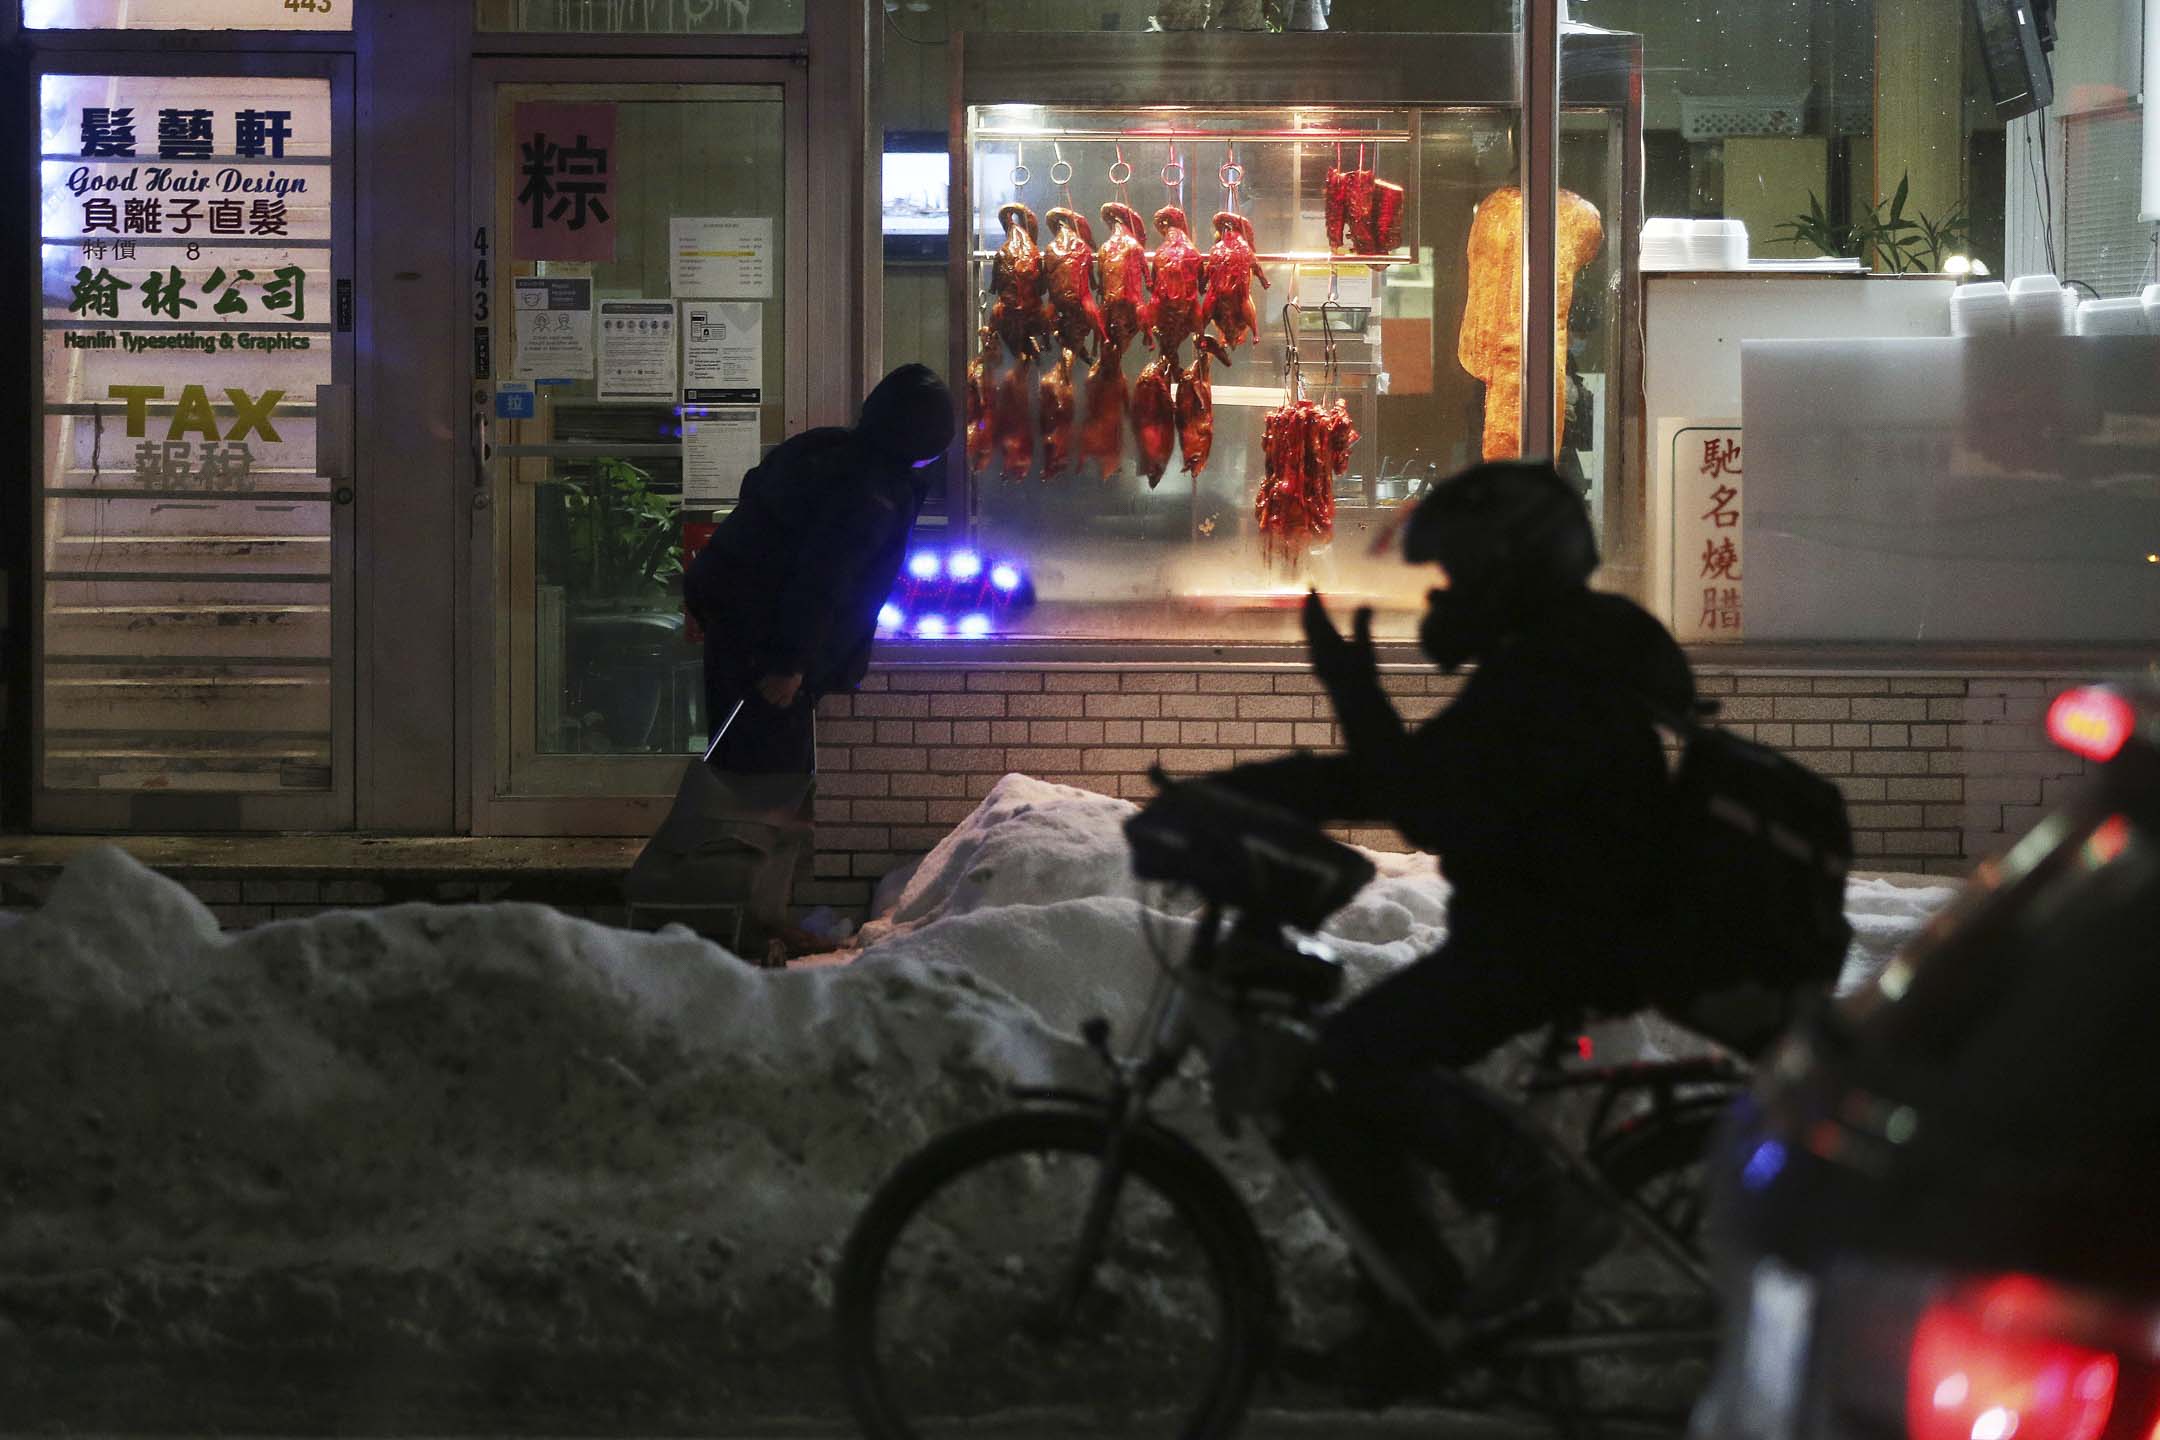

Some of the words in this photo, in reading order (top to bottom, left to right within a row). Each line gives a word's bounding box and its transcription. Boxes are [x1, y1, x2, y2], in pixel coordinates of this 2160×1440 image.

[80, 107, 293, 159] 髮藝軒
[66, 167, 138, 196] Good
[145, 167, 211, 193] Hair
[215, 167, 308, 198] Design
[517, 133, 610, 231] 粽
[81, 197, 289, 236] 負離子直髮
[82, 239, 138, 262] 特價
[186, 242, 201, 261] 8
[68, 265, 307, 321] 翰林公司
[64, 331, 117, 350] Hanlin
[120, 331, 216, 353] Typesetting
[219, 332, 235, 350] &
[237, 332, 311, 352] Graphics
[108, 384, 287, 443] TAX
